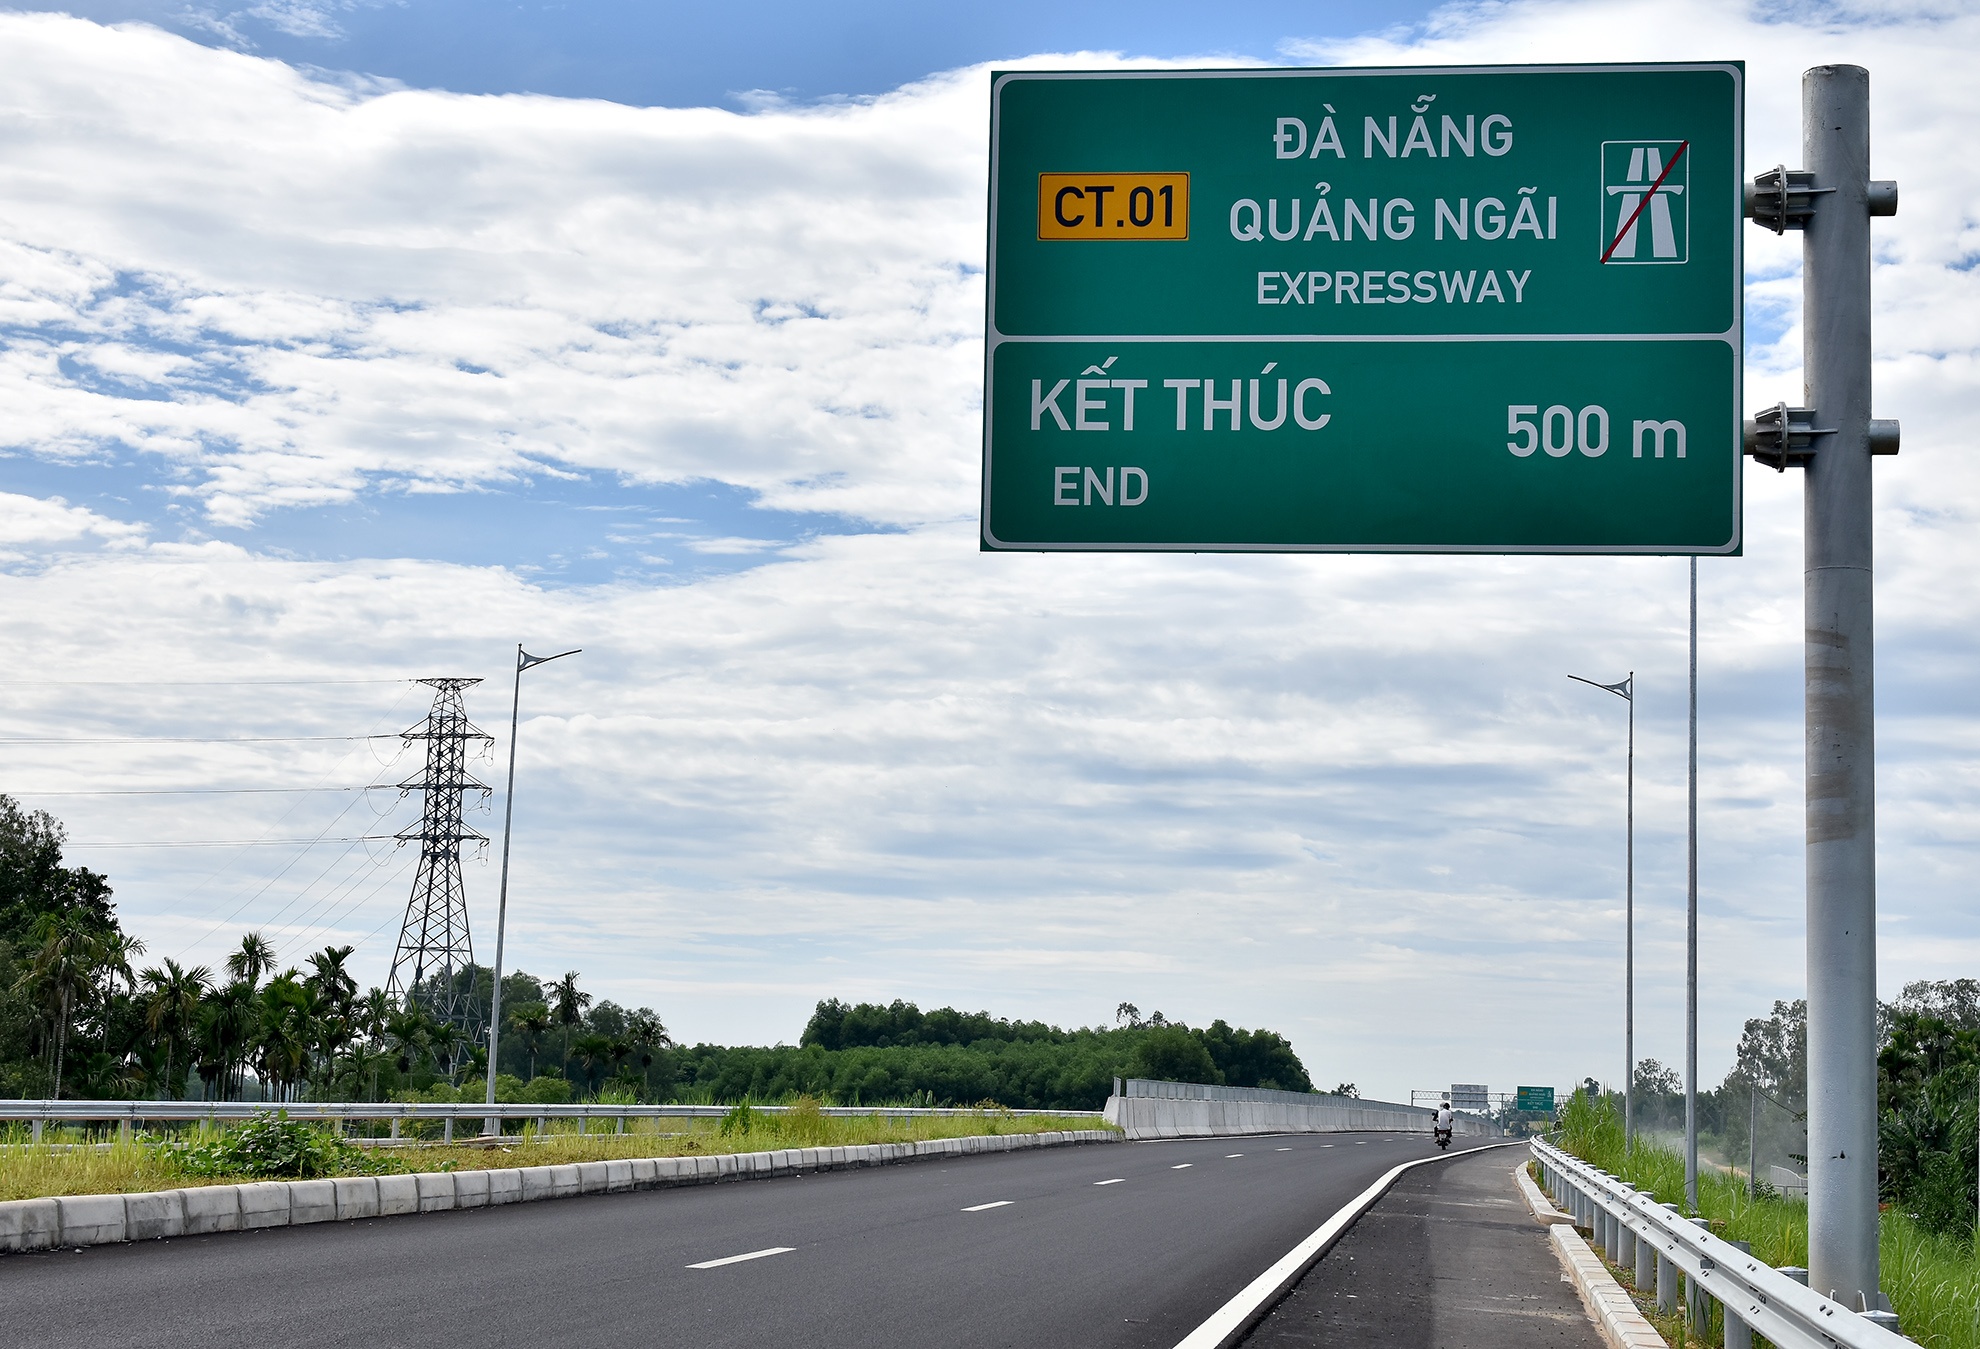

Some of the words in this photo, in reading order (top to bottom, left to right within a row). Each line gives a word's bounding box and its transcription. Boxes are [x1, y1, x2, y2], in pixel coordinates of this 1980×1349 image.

[1273, 103, 1346, 160] ĐÀ
[1364, 94, 1513, 159] NẴNG
[1053, 185, 1174, 228] CT.01
[1229, 181, 1416, 242] QUẢNG
[1434, 186, 1557, 241] NGÃI
[1257, 269, 1532, 305] EXPRESSWAY
[1030, 356, 1148, 432] KẾT
[1163, 362, 1332, 432] THÚC
[1507, 404, 1610, 459] 500
[1632, 419, 1688, 459] m
[1053, 466, 1149, 507] END
